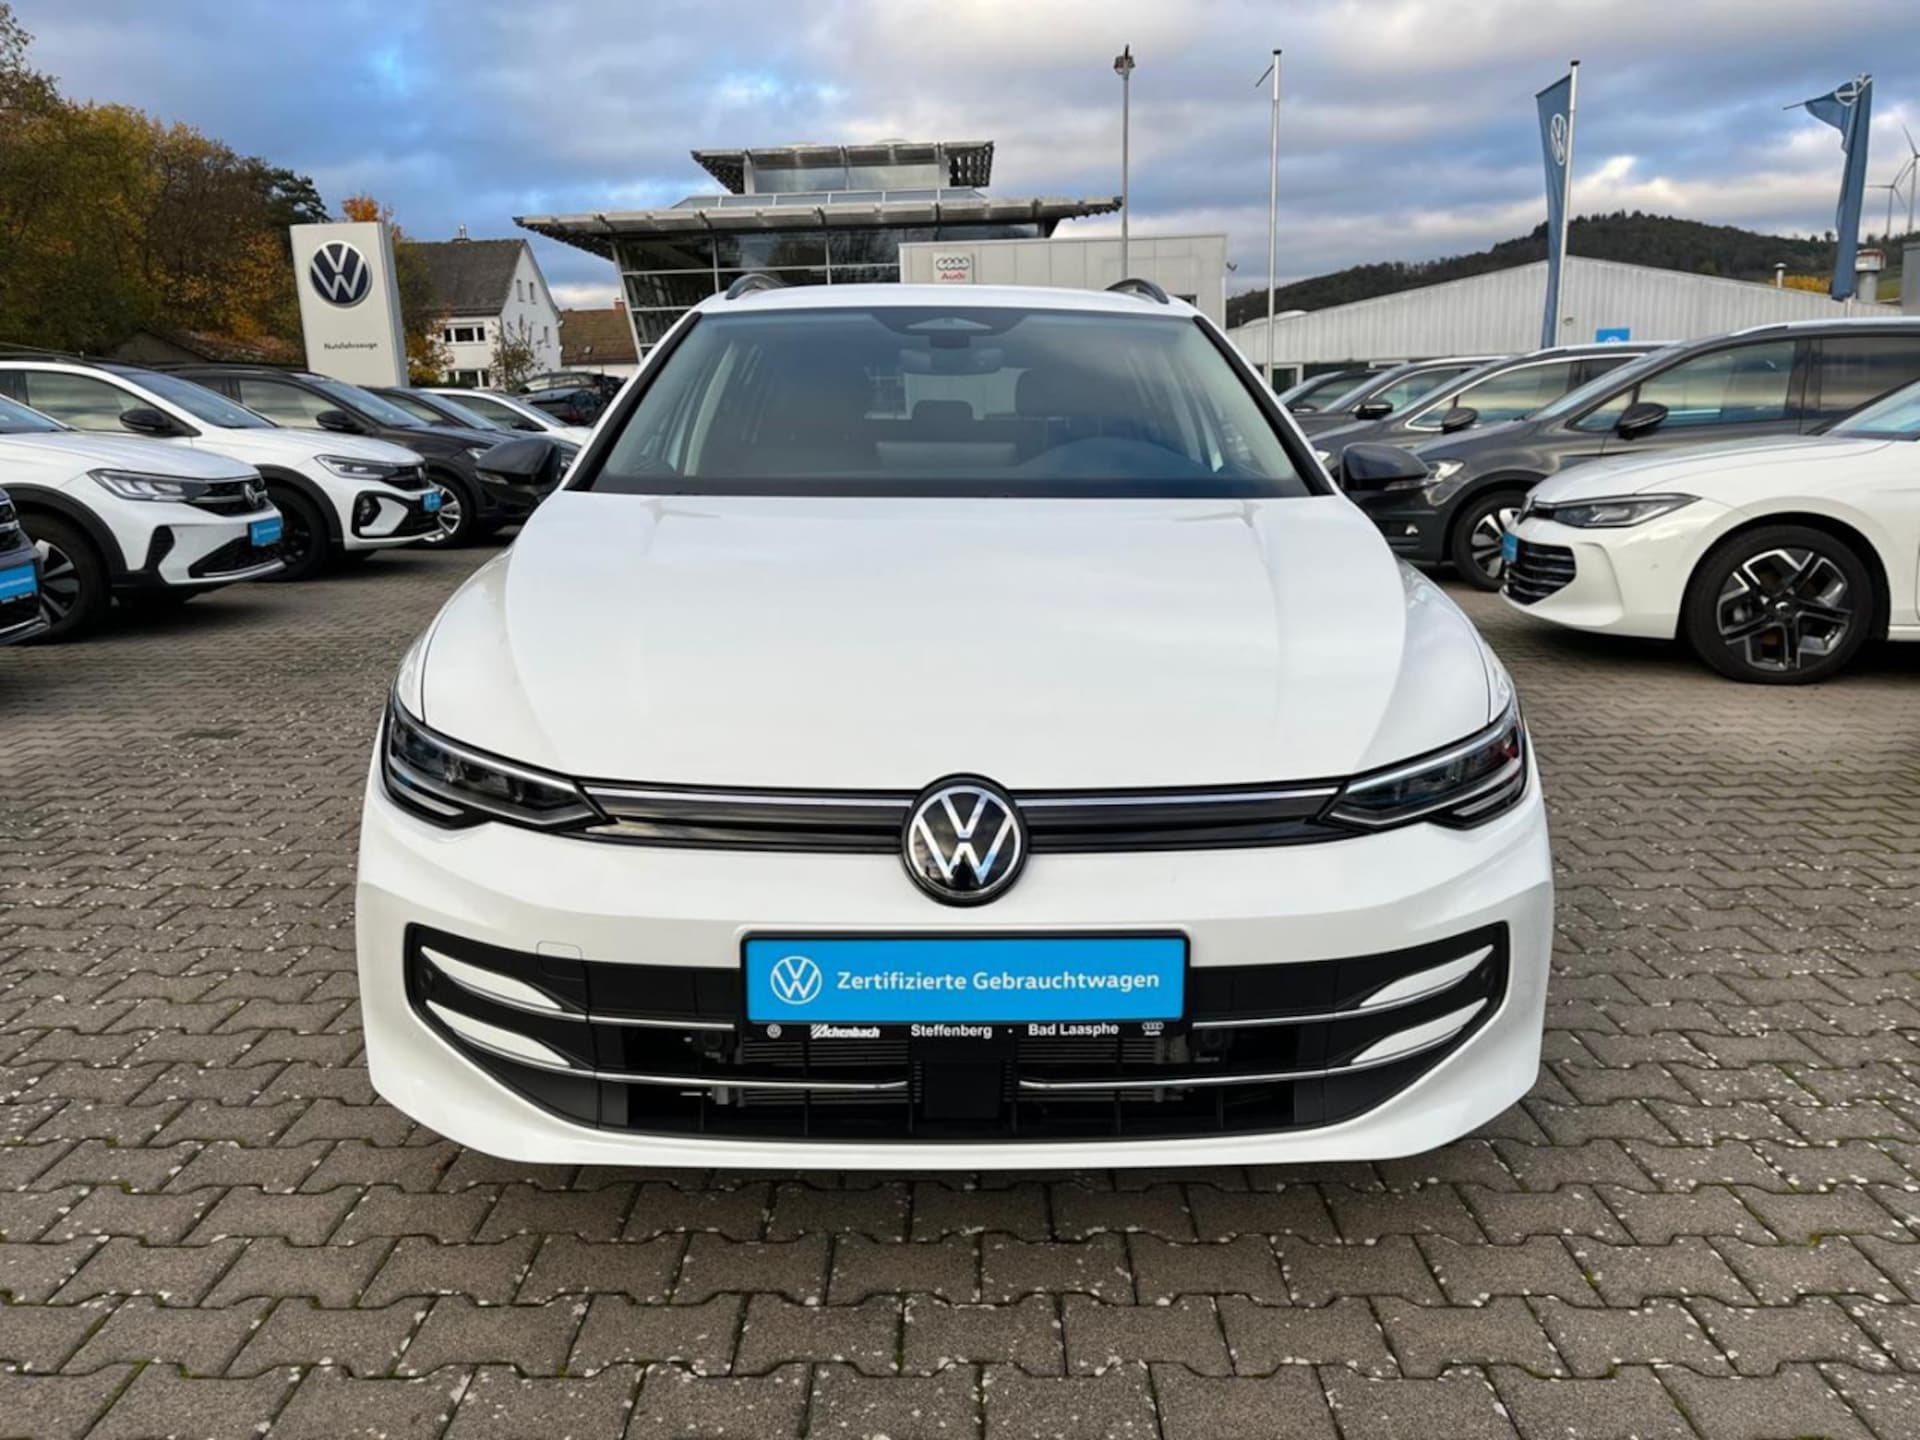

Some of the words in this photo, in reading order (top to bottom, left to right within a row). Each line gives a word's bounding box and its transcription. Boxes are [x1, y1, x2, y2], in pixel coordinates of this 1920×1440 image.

[310, 242, 371, 307] VW
[941, 272, 966, 280] Audi
[908, 785, 1021, 898] VW
[770, 955, 822, 1005] VW
[837, 971, 967, 990] Zertifizierte
[972, 971, 1160, 993] Gebrauchtwagen
[910, 1023, 993, 1039] Steffenberg
[1028, 1023, 1056, 1036] Bad
[1059, 1022, 1120, 1037] Laasphe
